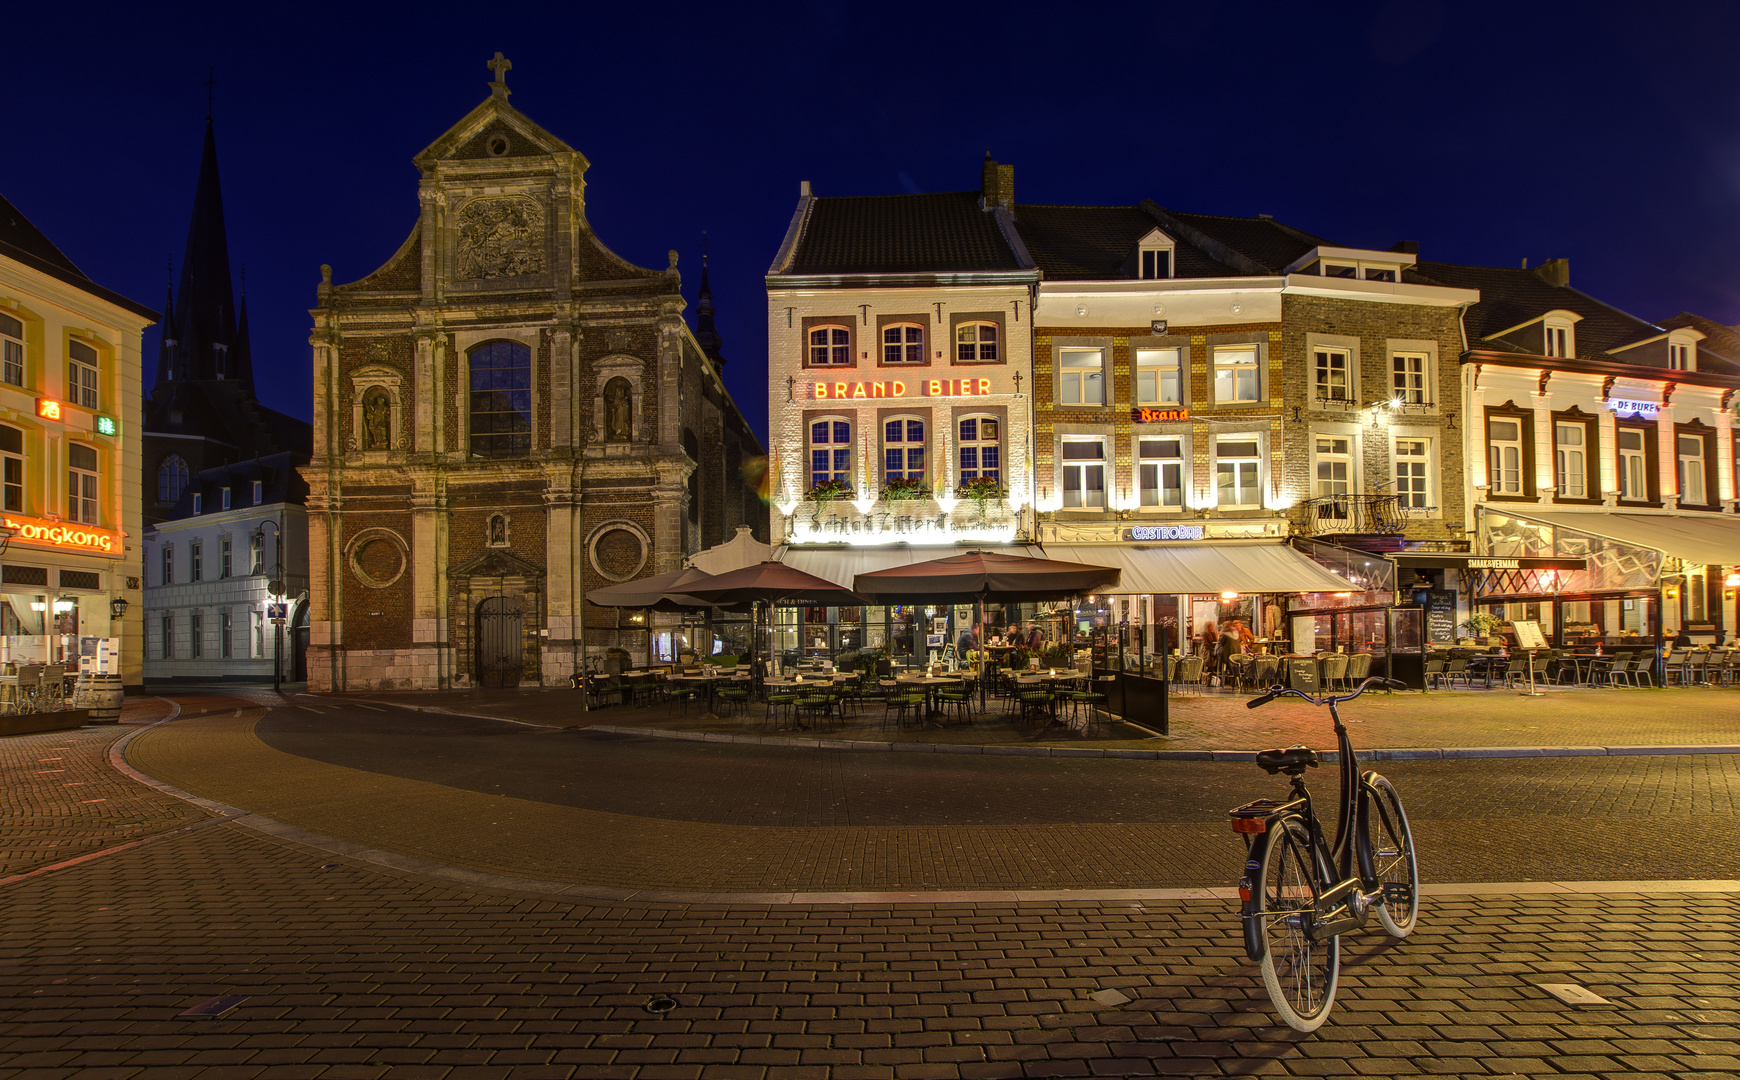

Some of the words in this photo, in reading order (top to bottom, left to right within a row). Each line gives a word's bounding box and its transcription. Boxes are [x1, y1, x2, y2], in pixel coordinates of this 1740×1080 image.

[814, 380, 906, 399] BRAND
[929, 378, 992, 396] BIER
[1617, 401, 1629, 409] DE
[1141, 406, 1189, 422] Brand
